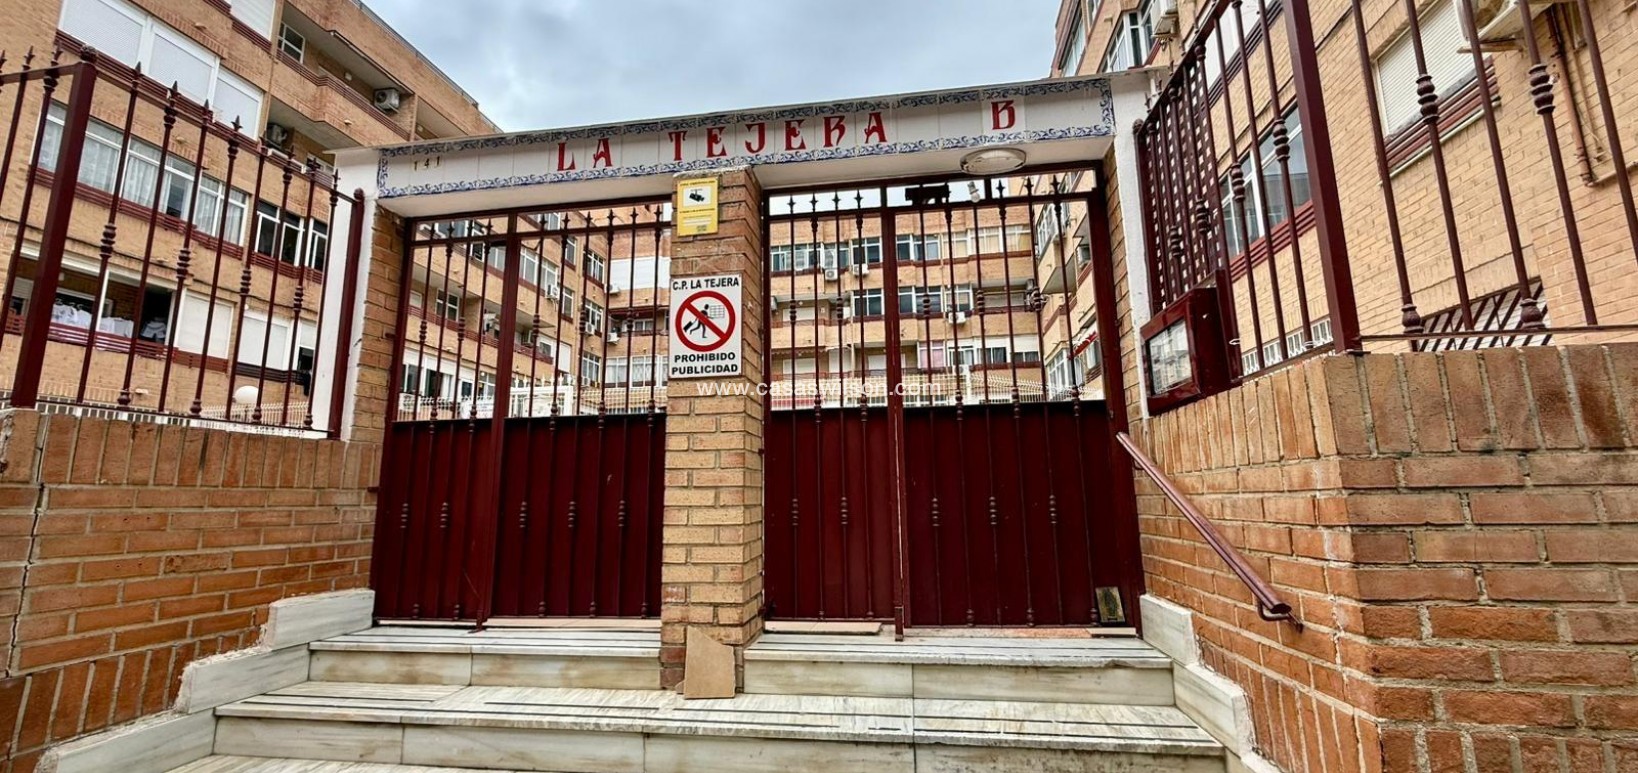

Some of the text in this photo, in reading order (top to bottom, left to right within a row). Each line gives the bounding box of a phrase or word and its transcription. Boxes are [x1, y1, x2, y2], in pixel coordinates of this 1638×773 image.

[557, 100, 1016, 171] LA TEJERA B
[672, 277, 739, 291] C.P. LA TEJERA
[674, 352, 736, 363] PROHIBIDO
[671, 364, 739, 376] PUBLICIDAD
